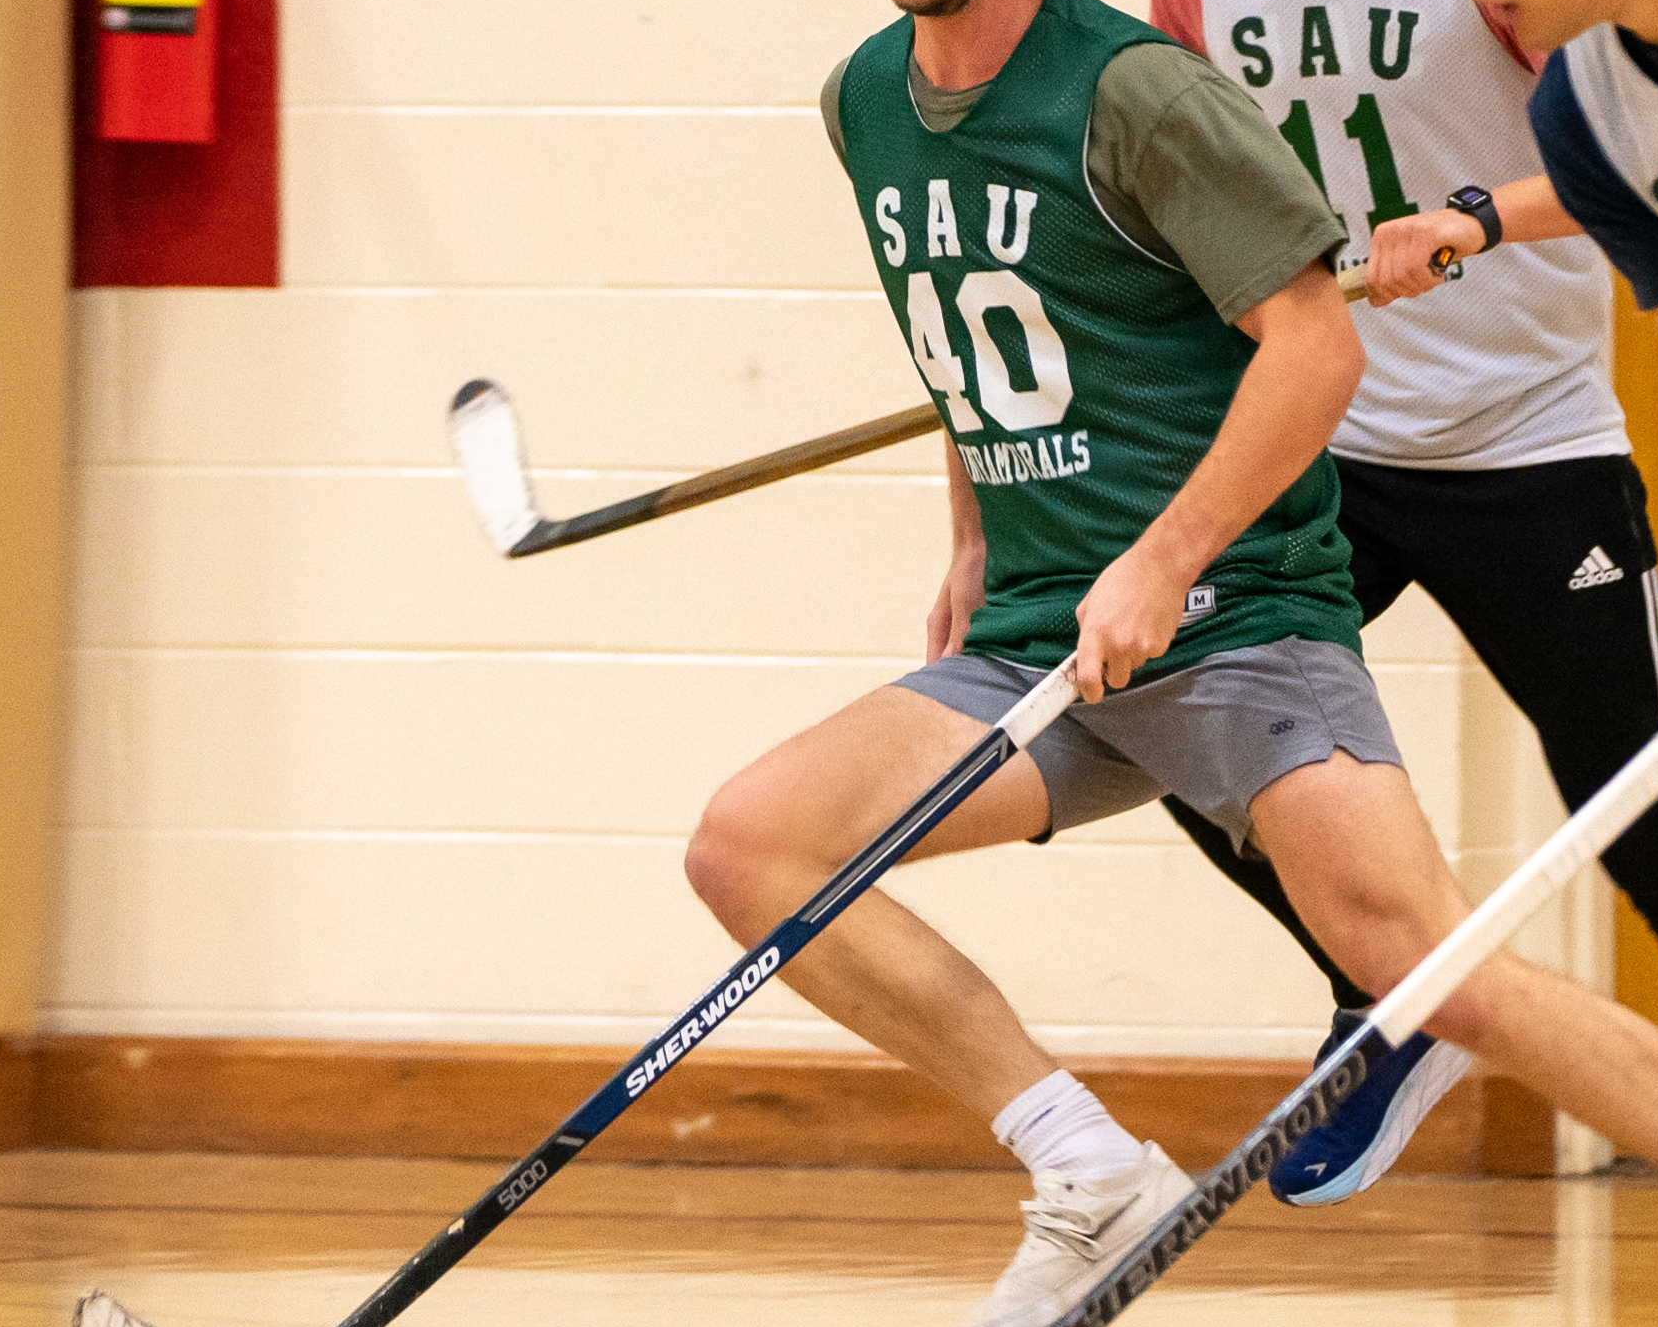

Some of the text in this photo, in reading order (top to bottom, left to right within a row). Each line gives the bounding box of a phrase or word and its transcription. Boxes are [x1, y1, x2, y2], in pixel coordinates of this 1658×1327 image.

[1231, 5, 1419, 88] SAU
[876, 179, 1038, 267] SAU
[907, 270, 1074, 433] 40
[1194, 593, 1206, 607] M
[625, 946, 781, 1098] SHER-WOOD
[498, 1158, 548, 1211] 5000
